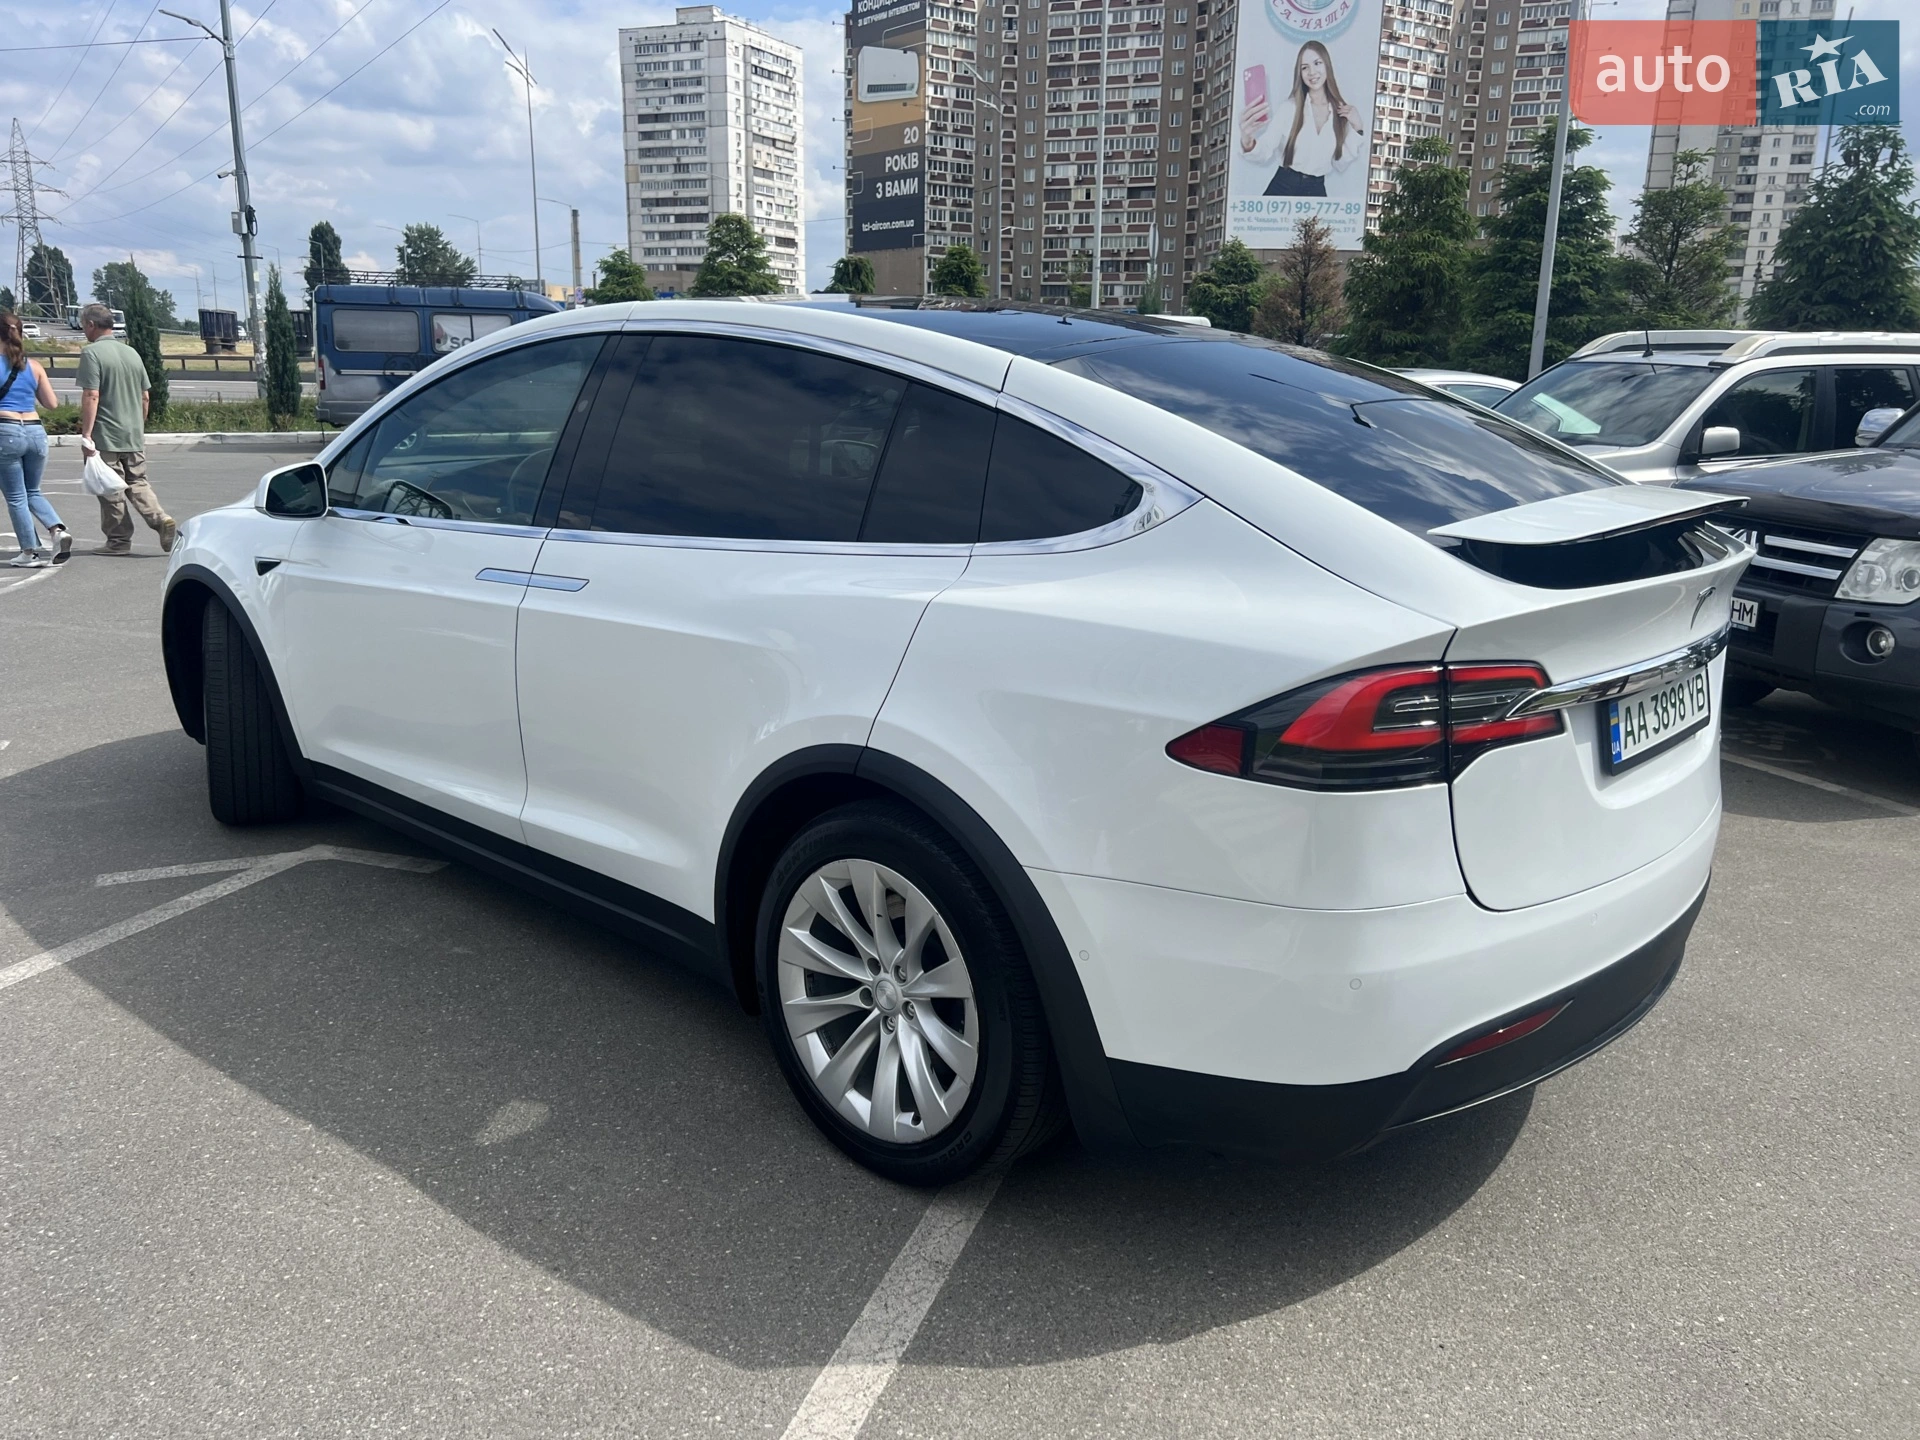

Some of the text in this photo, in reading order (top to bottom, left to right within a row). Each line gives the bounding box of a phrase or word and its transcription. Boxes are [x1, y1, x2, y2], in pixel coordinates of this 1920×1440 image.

[903, 126, 919, 145] 20
[885, 152, 919, 173] РОКІВ
[885, 177, 919, 197] ВАМИ
[1230, 200, 1361, 215] +380 (97) 99-777-89
[1731, 600, 1754, 624] HM
[1624, 673, 1706, 750] AA 3898 YB
